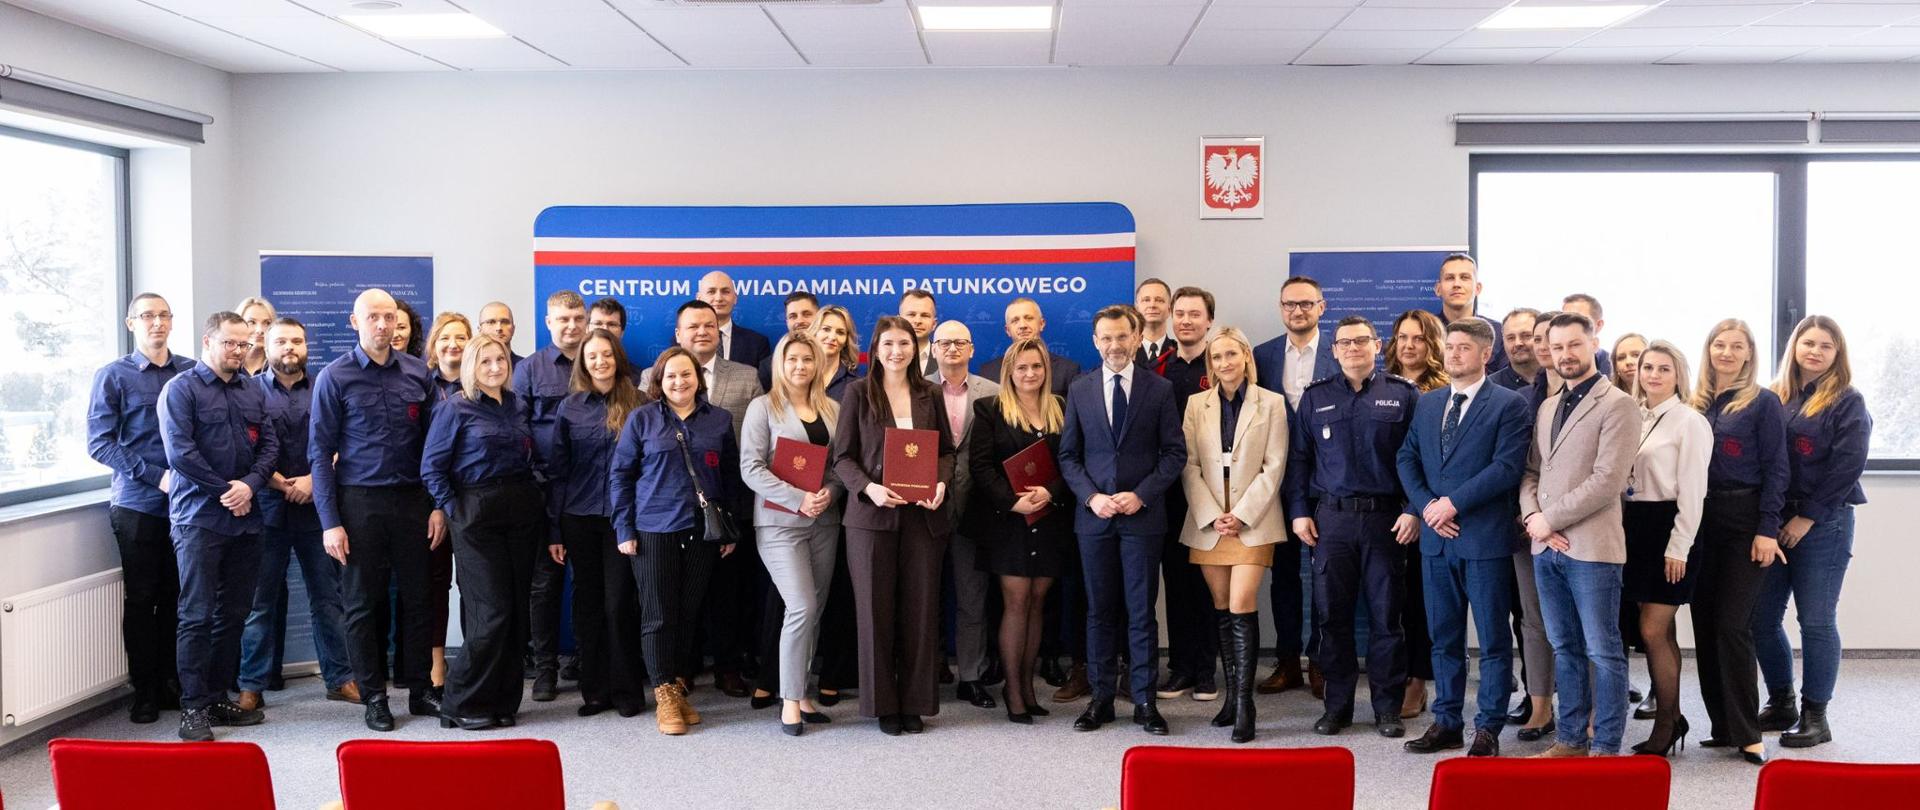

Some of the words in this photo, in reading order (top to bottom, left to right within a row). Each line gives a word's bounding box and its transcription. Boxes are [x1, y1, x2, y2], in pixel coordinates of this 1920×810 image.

[578, 279, 691, 296] CENTRUM
[698, 278, 896, 296] WIADAMIANIA
[903, 276, 1087, 295] RATUNKOWEGO
[1374, 399, 1400, 407] POLICJA
